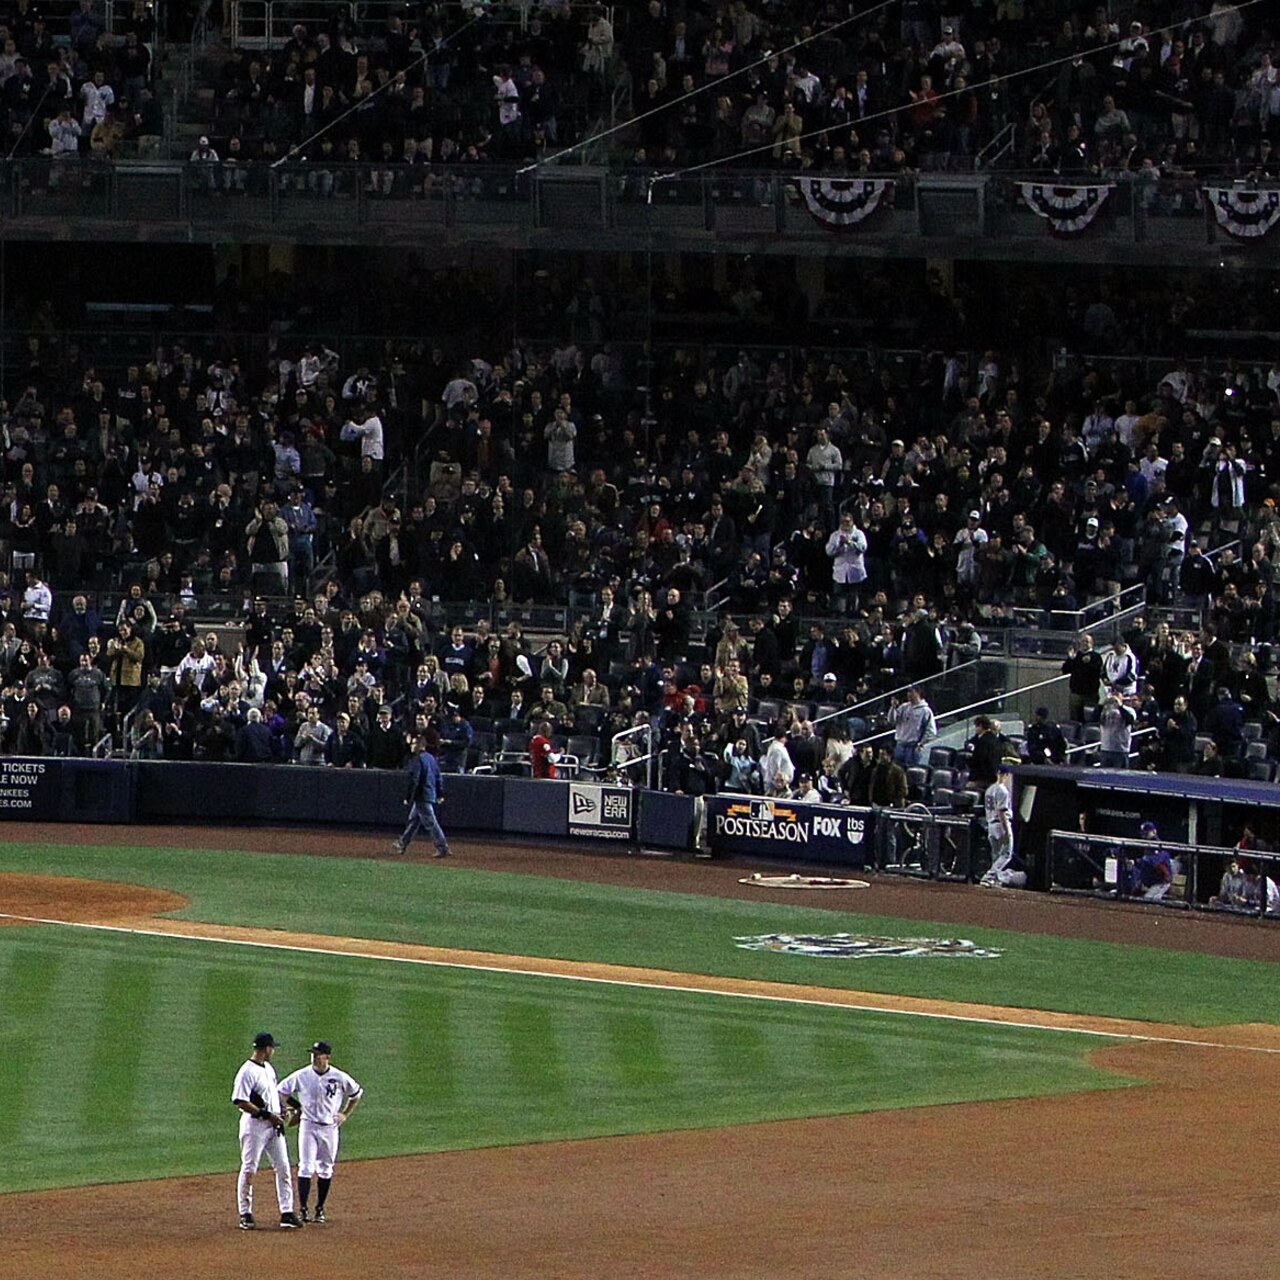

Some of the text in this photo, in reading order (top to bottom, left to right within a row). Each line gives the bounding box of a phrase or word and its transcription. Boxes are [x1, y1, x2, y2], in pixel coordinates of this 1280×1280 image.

[2, 763, 46, 774] TICKETS
[10, 775, 39, 786] NOW
[604, 794, 628, 807] NEW
[604, 806, 627, 819] ERA
[715, 814, 810, 844] POSTSEASON
[812, 815, 865, 838] FOX tbs
